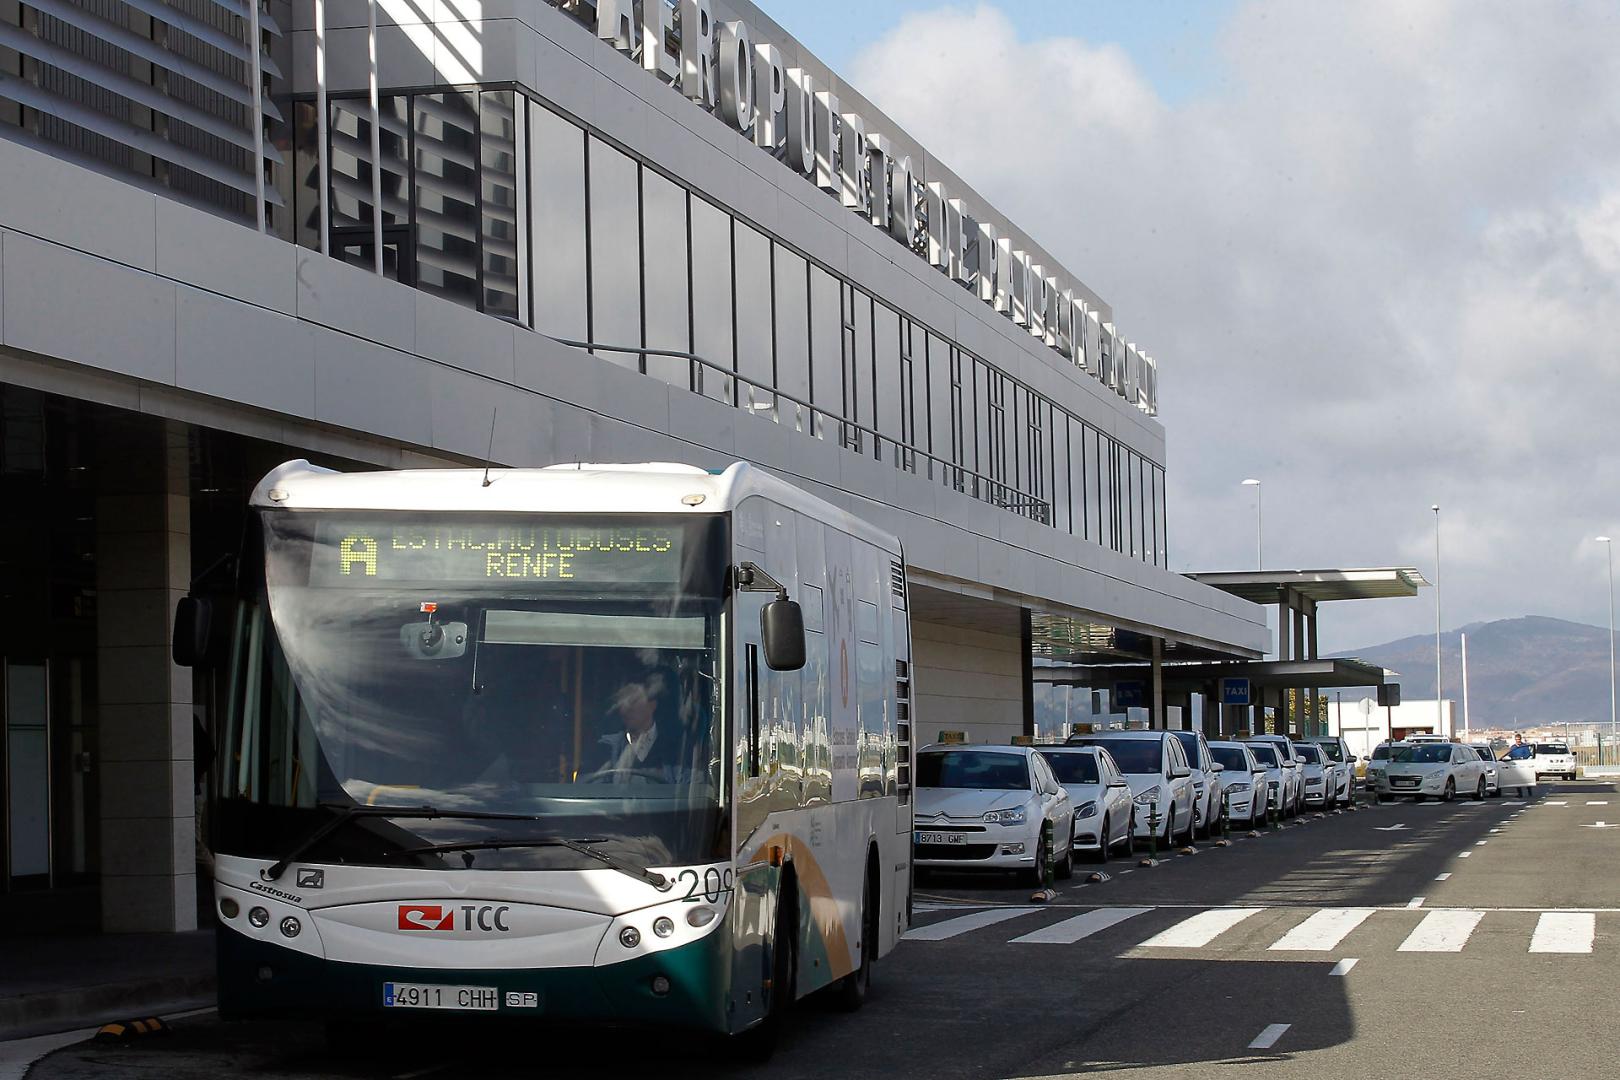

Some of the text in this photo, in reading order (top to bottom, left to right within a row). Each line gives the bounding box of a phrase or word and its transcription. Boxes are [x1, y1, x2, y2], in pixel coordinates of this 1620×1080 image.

[927, 181, 968, 286] DE
[340, 528, 377, 576] A
[486, 553, 575, 578] RENFE
[1225, 687, 1248, 696] TAXI
[921, 834, 942, 843] 8713
[249, 881, 302, 903] Castrosua
[678, 867, 733, 905] 209
[461, 905, 510, 931] TCC
[396, 987, 442, 1007] 4911
[457, 989, 495, 1008] CHH
[508, 993, 535, 1006] SP
